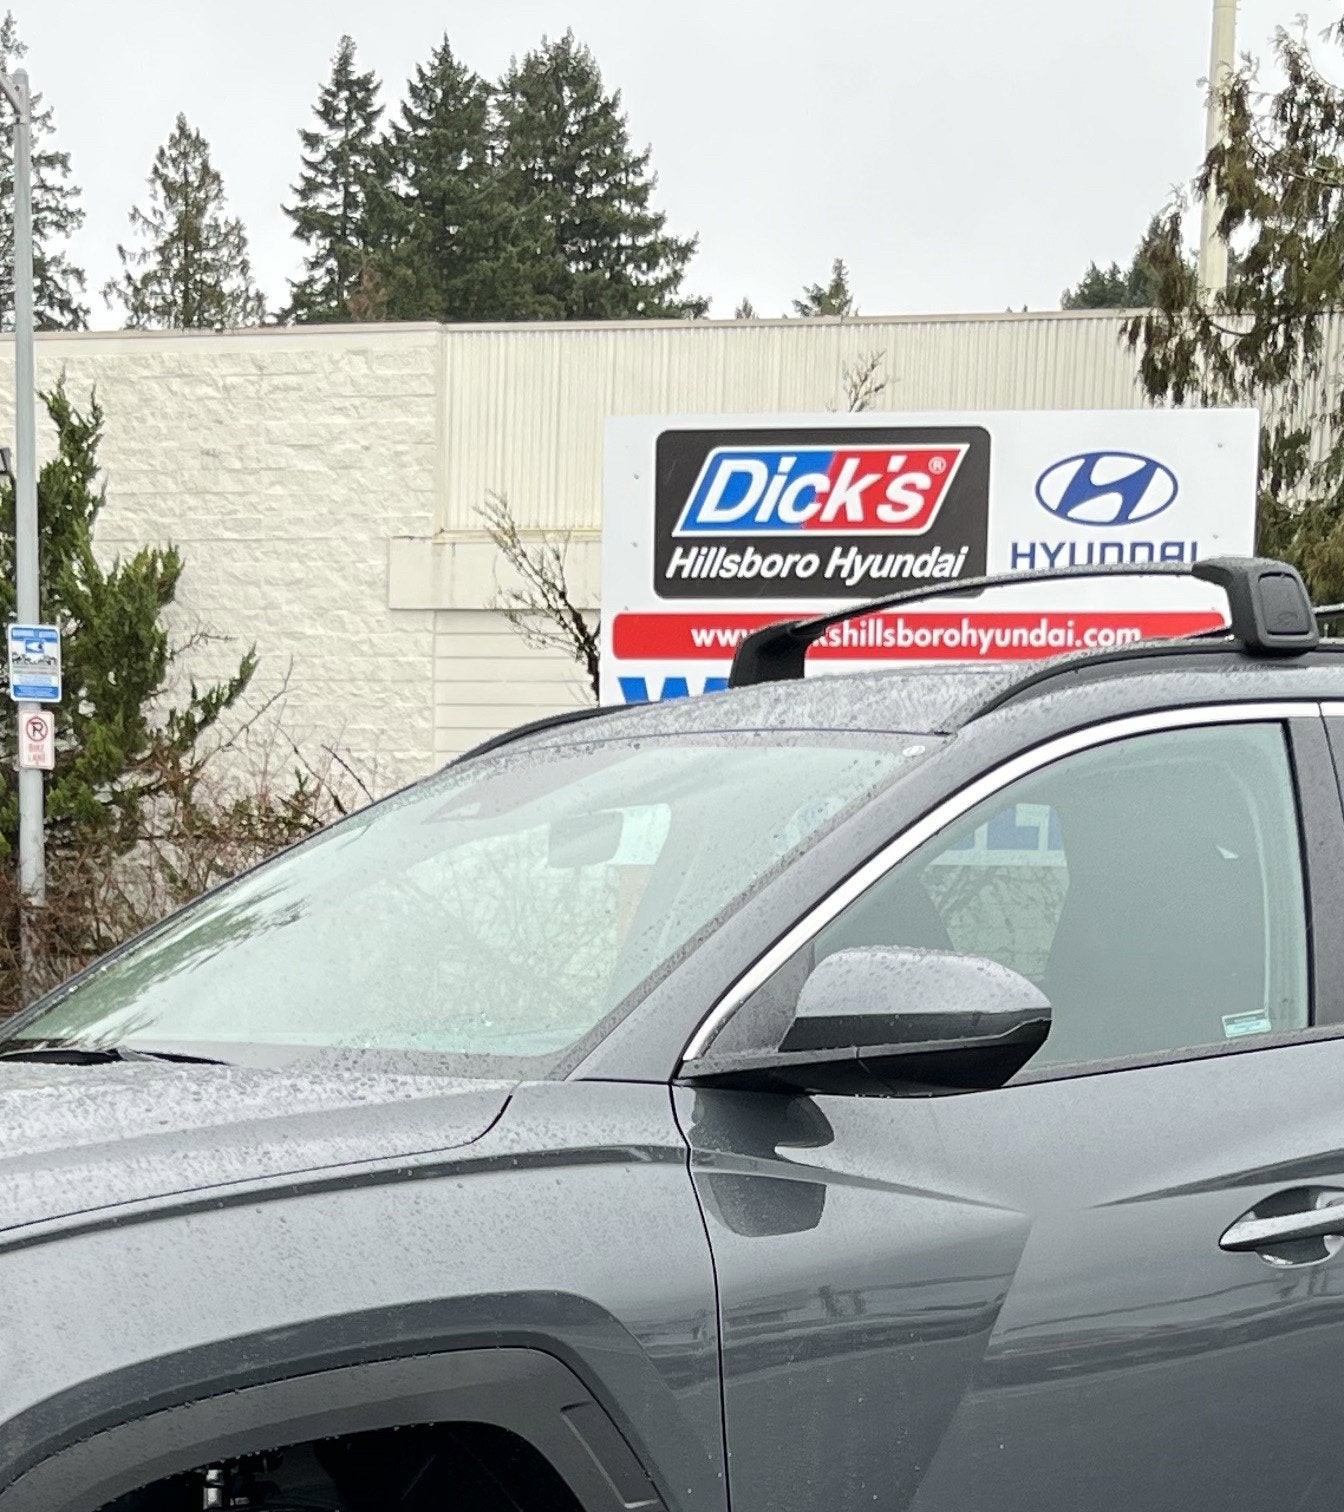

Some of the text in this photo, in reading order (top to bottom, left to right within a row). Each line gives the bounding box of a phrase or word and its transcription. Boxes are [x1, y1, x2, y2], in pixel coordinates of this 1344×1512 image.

[696, 456, 931, 523] Dick's
[666, 546, 970, 586] Hillsboro Hyundai
[1011, 541, 1199, 569] HYUNDAI
